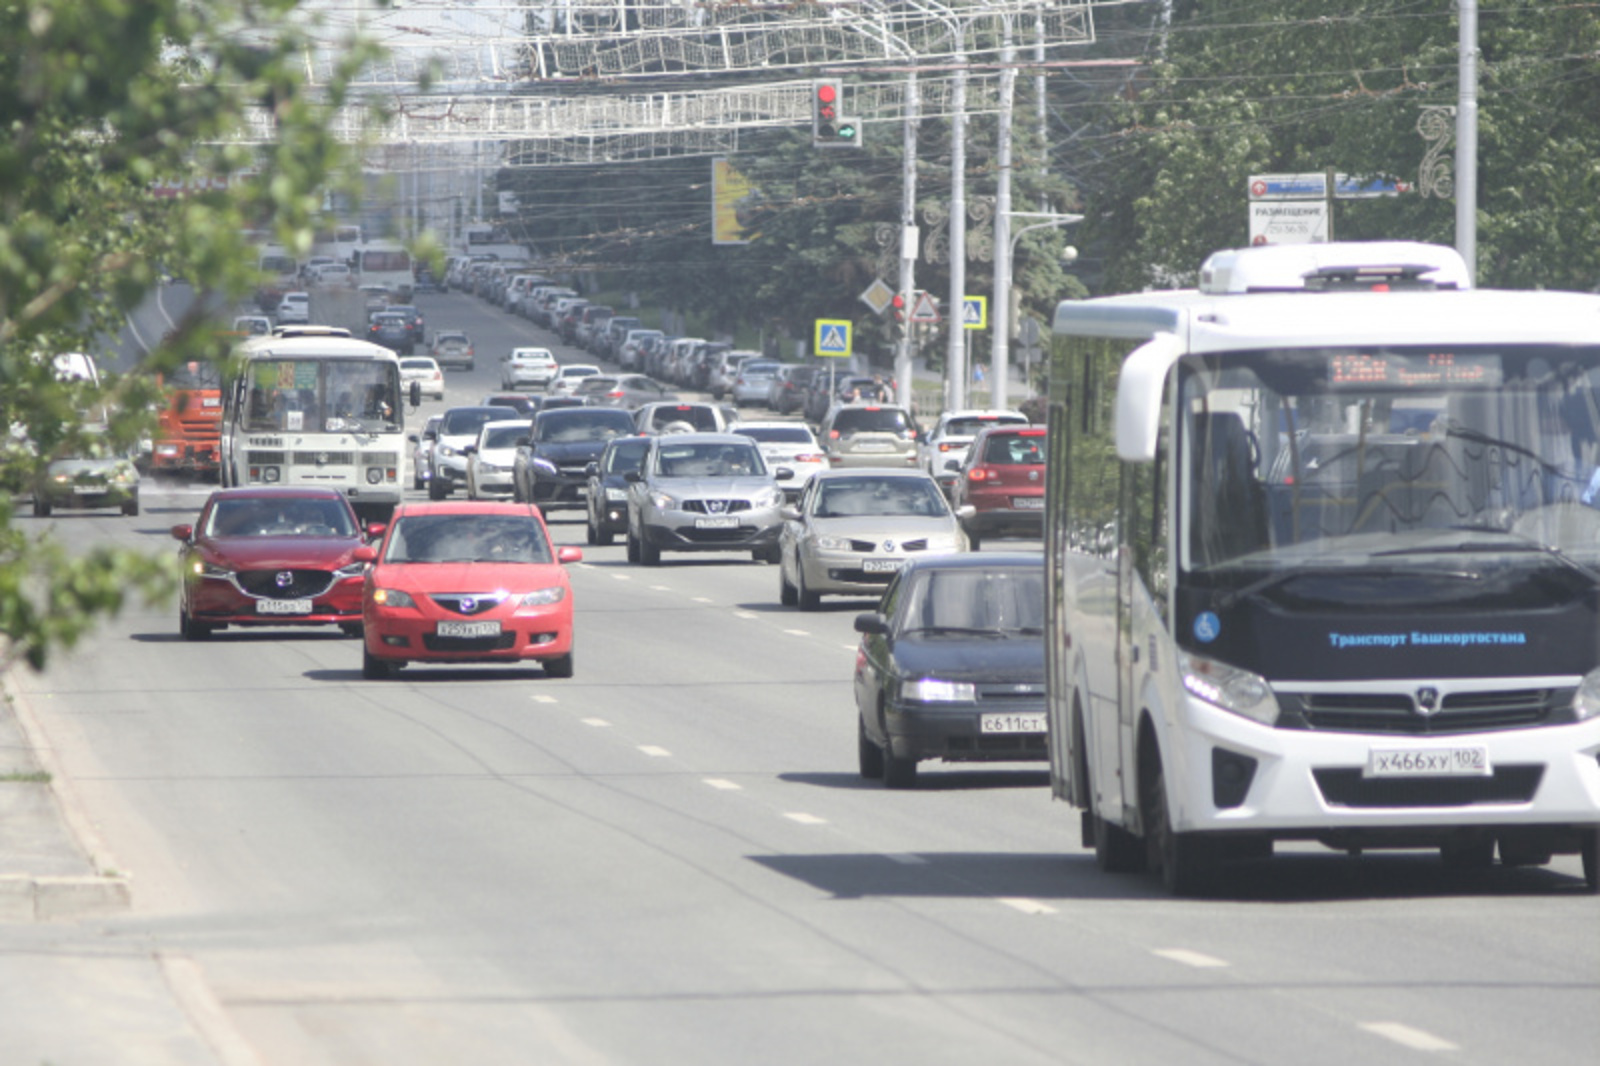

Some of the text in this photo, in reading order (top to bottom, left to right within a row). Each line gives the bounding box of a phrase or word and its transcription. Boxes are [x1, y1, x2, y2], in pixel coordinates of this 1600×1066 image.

[1328, 631, 1526, 648] Транспорт Башкортостана
[1379, 750, 1481, 771] Х466ХУ 102
